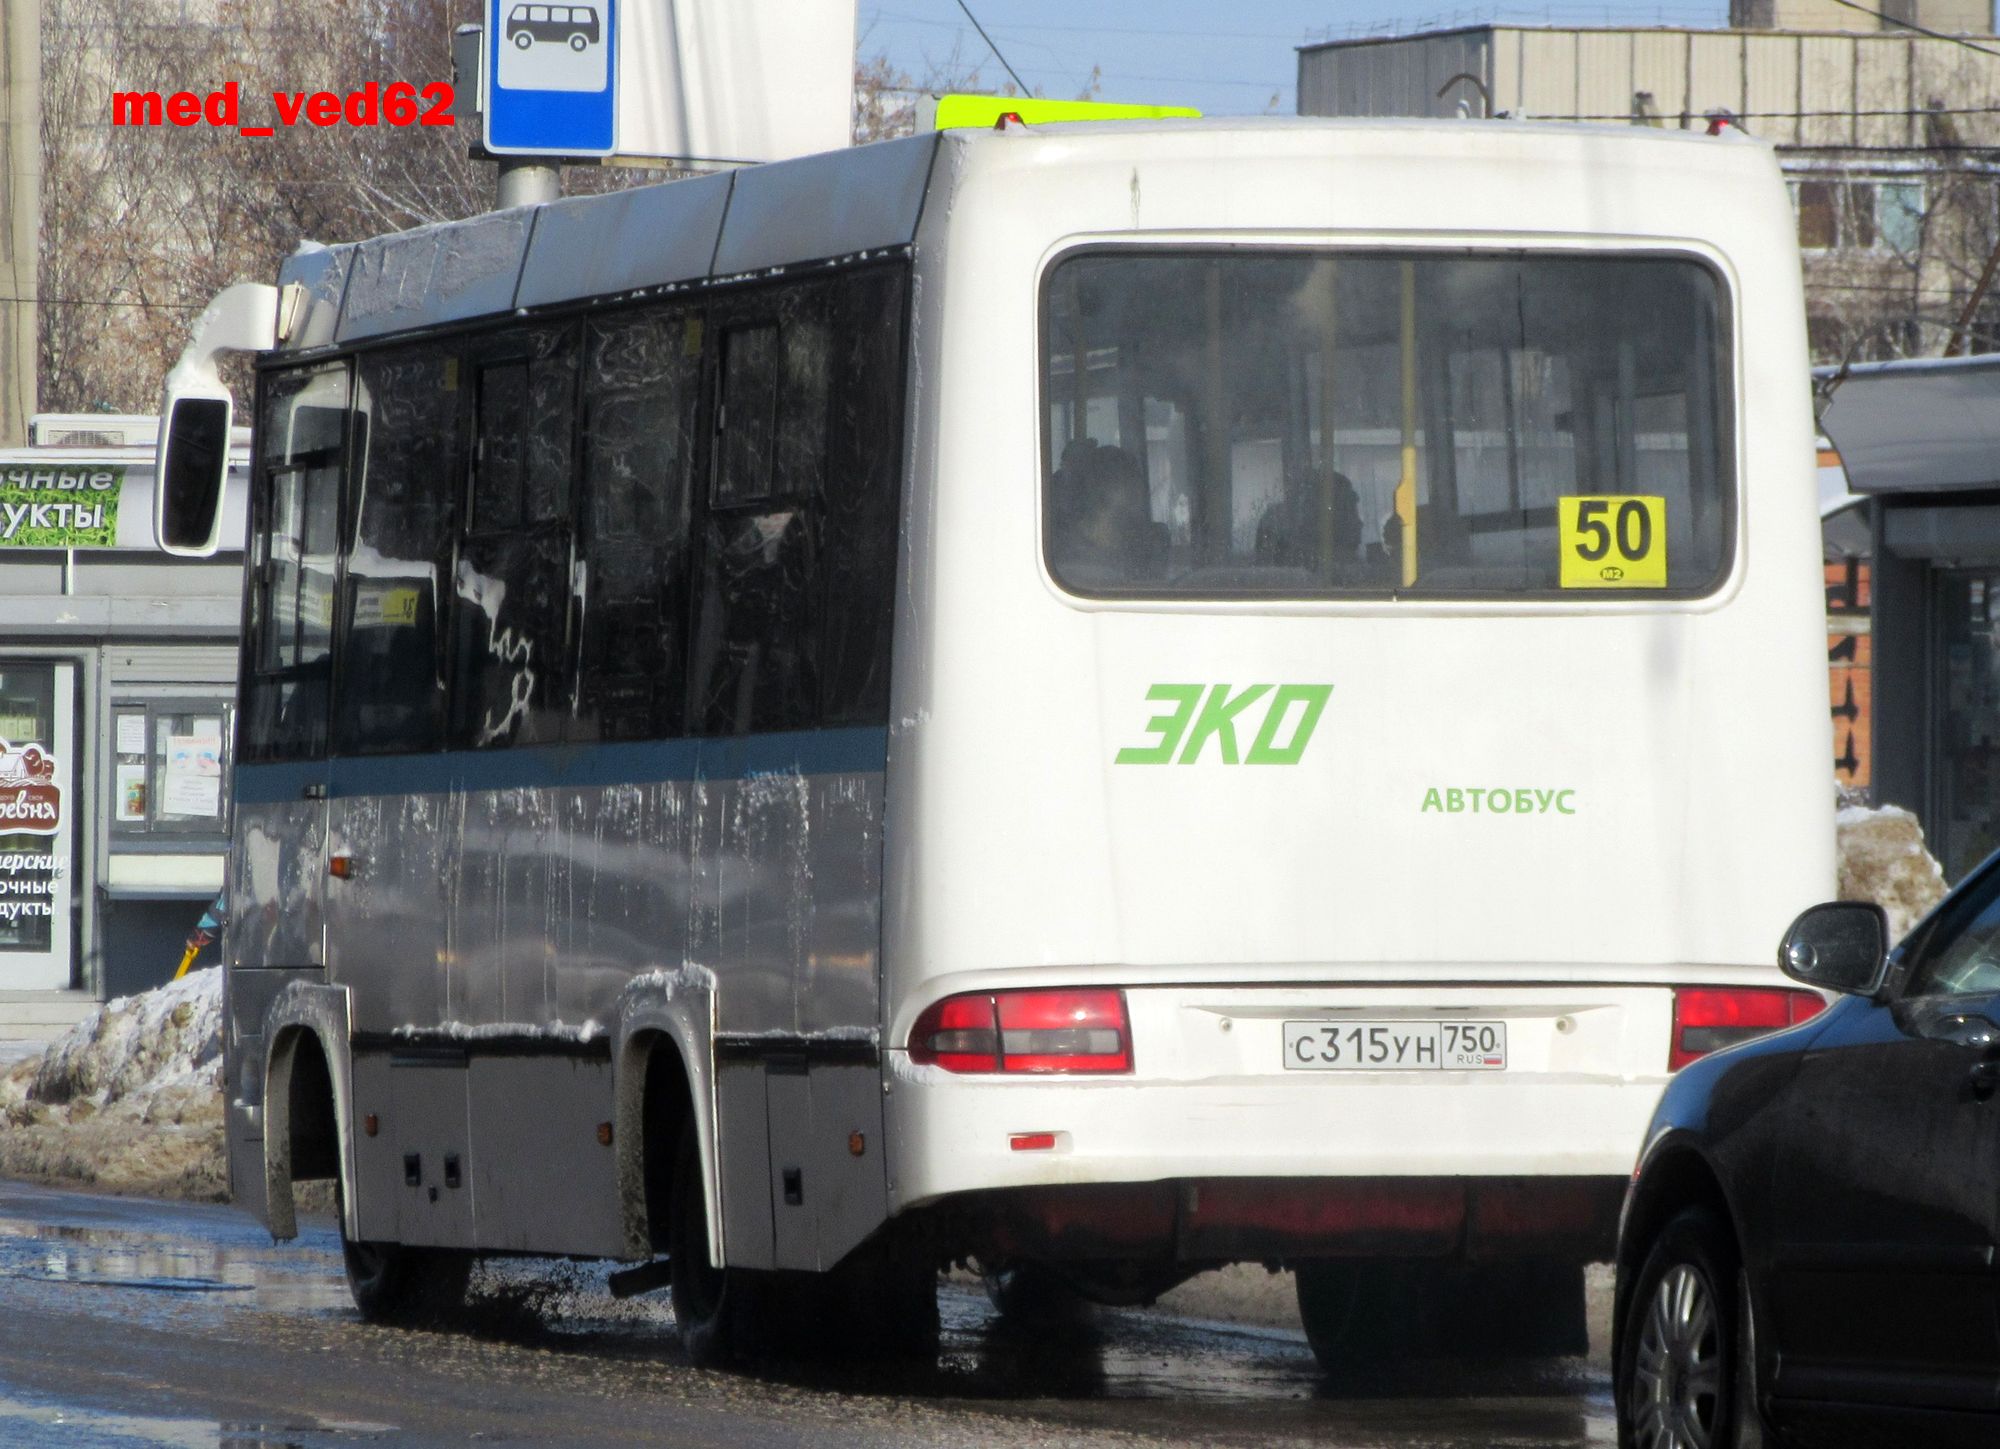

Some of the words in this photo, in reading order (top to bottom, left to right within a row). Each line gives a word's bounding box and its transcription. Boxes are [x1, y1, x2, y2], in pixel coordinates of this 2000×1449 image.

[0, 503, 102, 538] укты
[1575, 500, 1652, 561] 50
[1114, 684, 1334, 765] ЭКО
[1421, 788, 1576, 814] АВТОБУС
[1295, 1028, 1435, 1063] С315УН
[1444, 1026, 1496, 1052] 750
[1457, 1054, 1483, 1064] RUS
